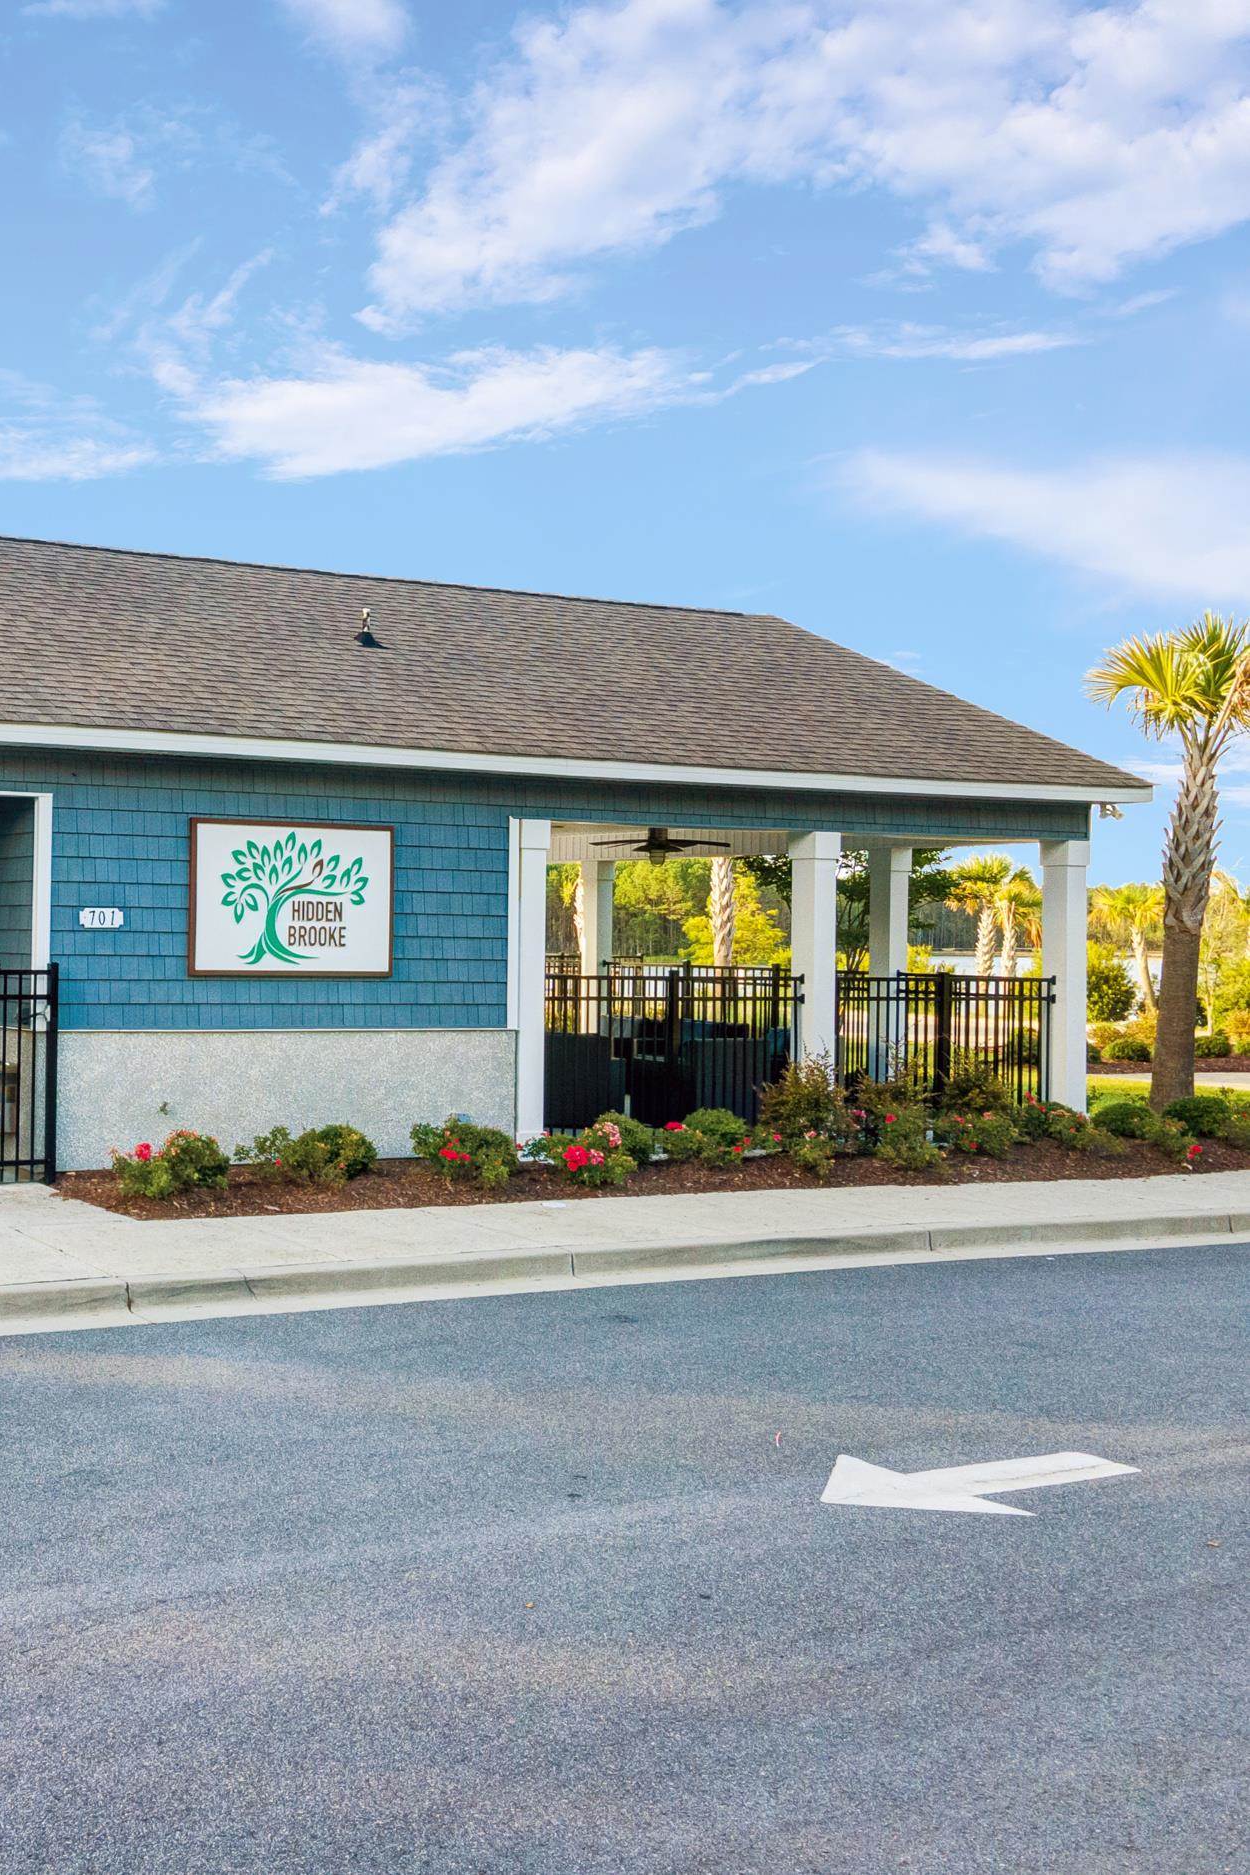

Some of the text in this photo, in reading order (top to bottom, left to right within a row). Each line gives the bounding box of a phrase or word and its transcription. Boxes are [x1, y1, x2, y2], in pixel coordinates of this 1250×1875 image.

[89, 910, 115, 926] 701
[291, 900, 343, 922] HIDDEN
[287, 925, 347, 947] BROOKE
